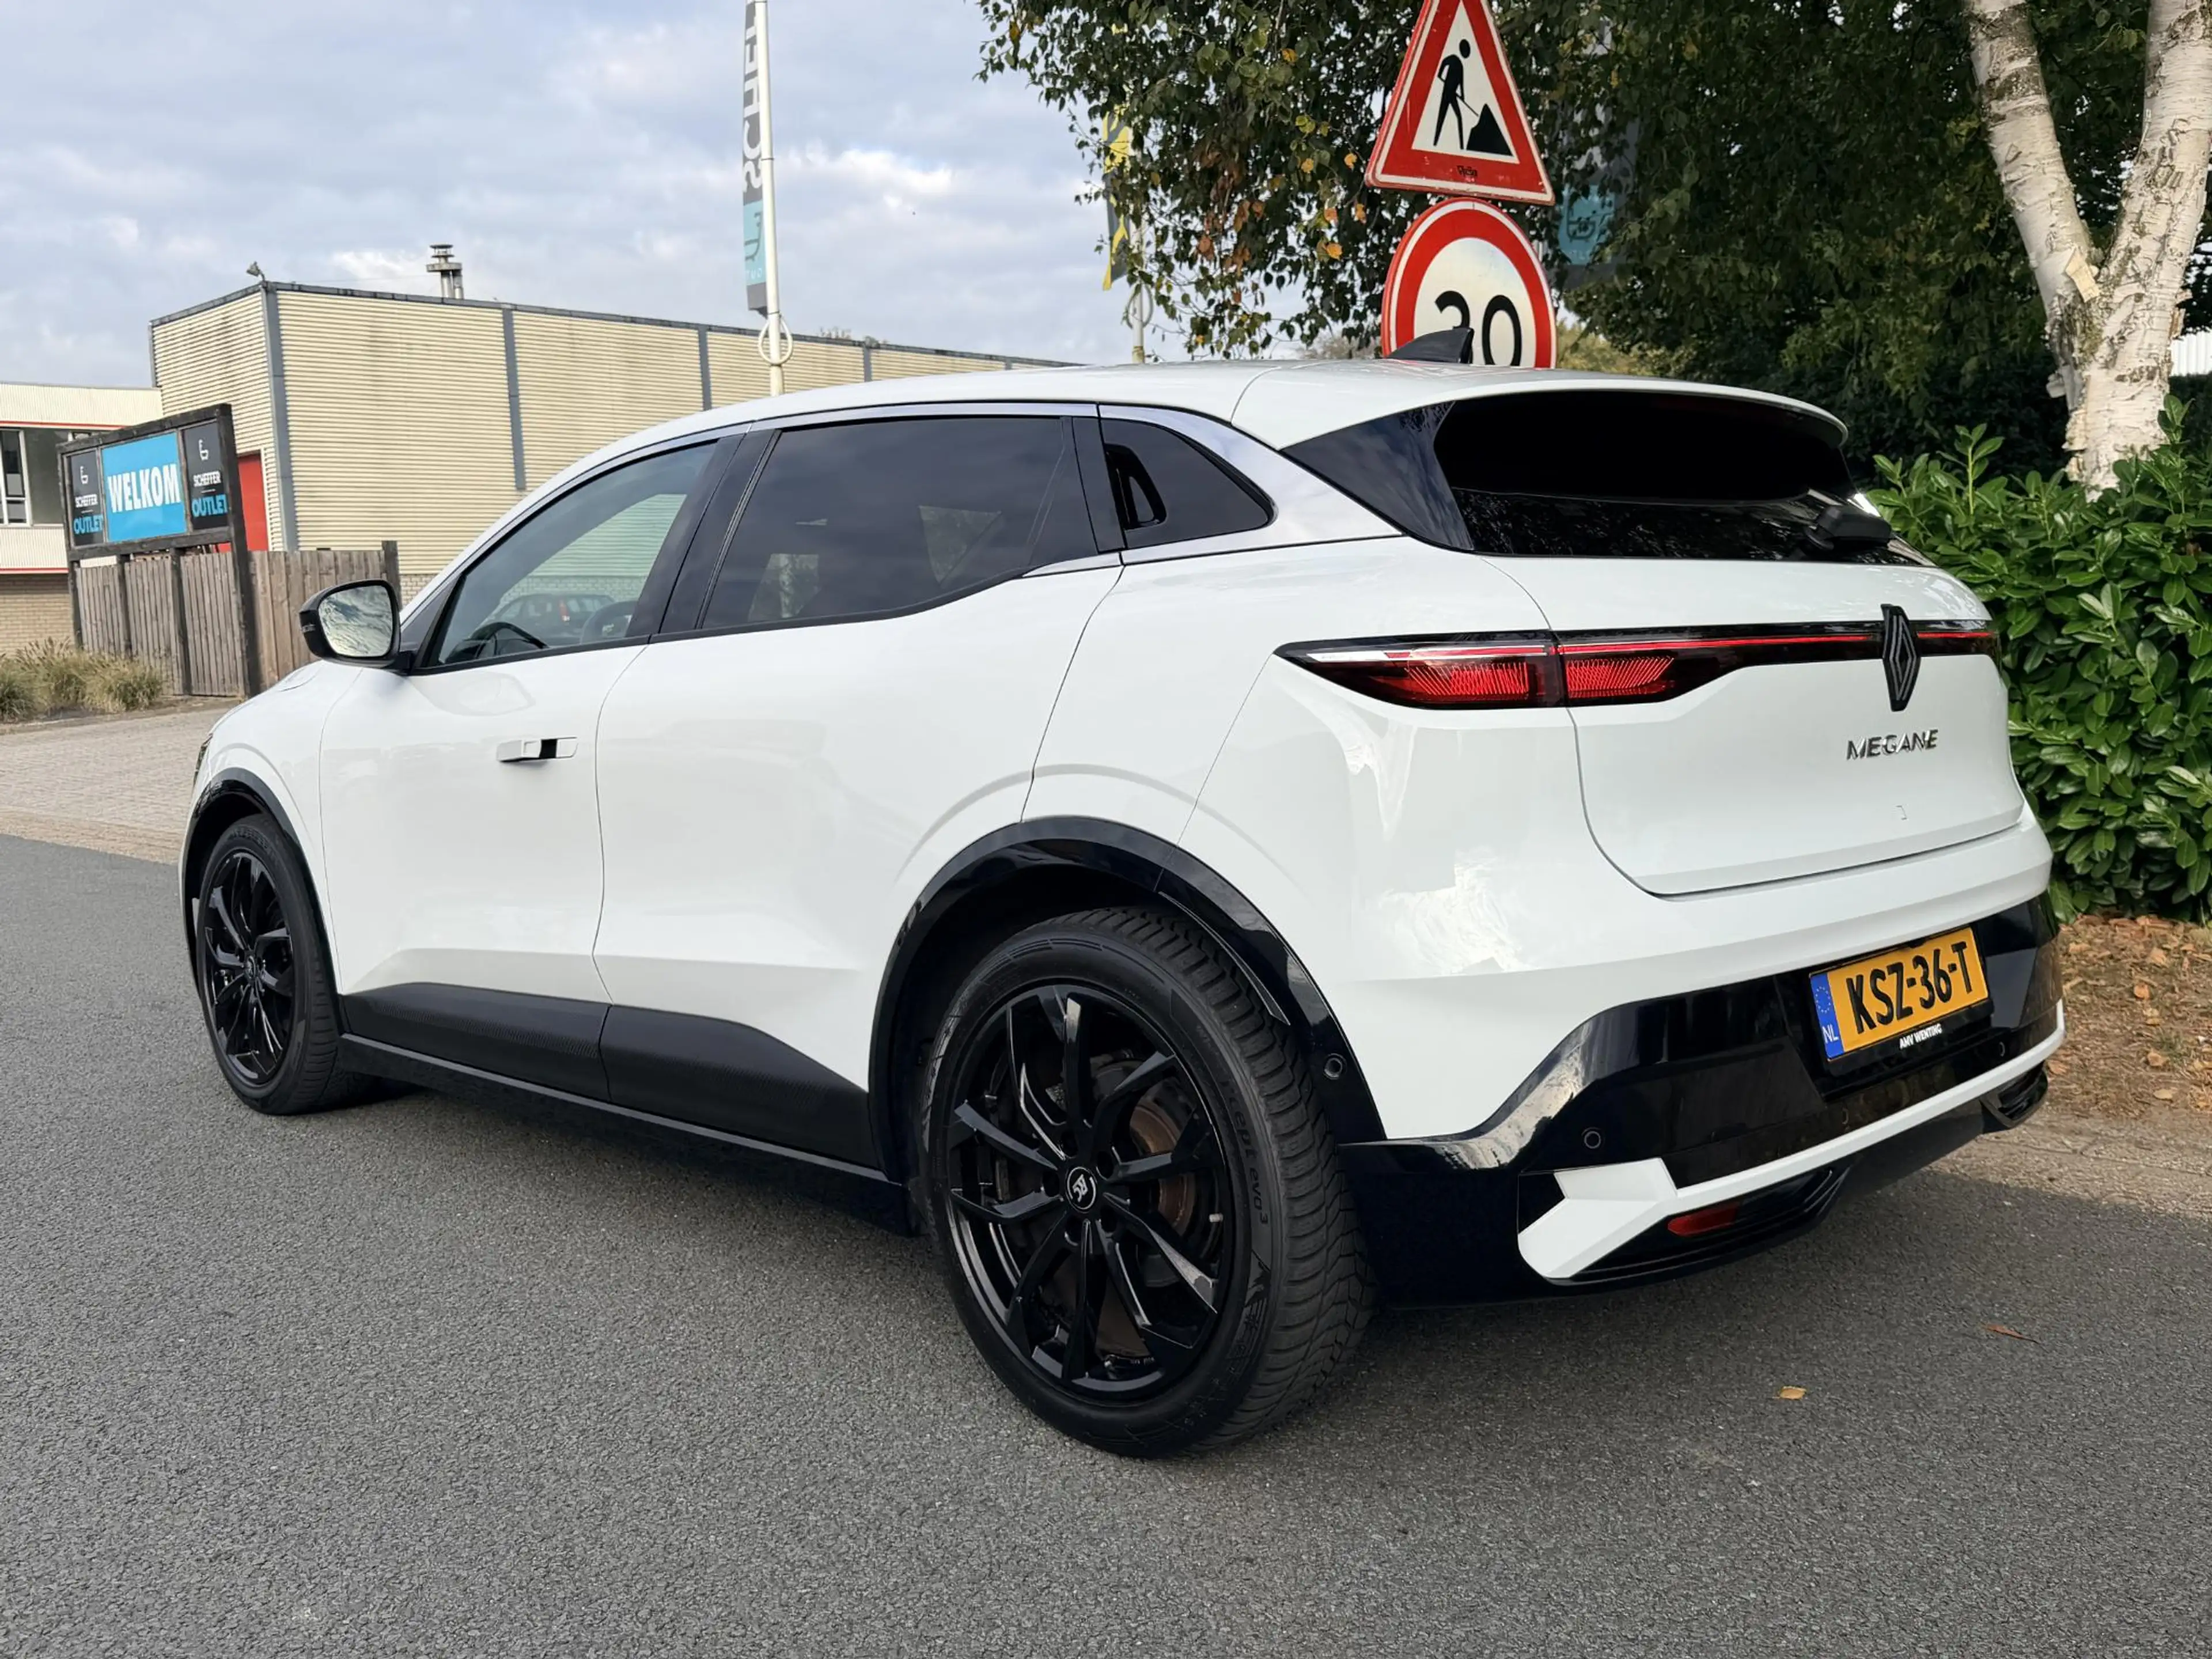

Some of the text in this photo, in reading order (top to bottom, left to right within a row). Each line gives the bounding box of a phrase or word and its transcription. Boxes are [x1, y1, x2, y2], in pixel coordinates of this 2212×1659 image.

[107, 463, 181, 513] WELKOM
[191, 494, 228, 518] OUTLET
[73, 514, 104, 535] OUTLET
[1847, 729, 1939, 760] MEGANE
[1846, 941, 1973, 1035] KSZ-36-T
[1821, 1023, 1840, 1044] NL
